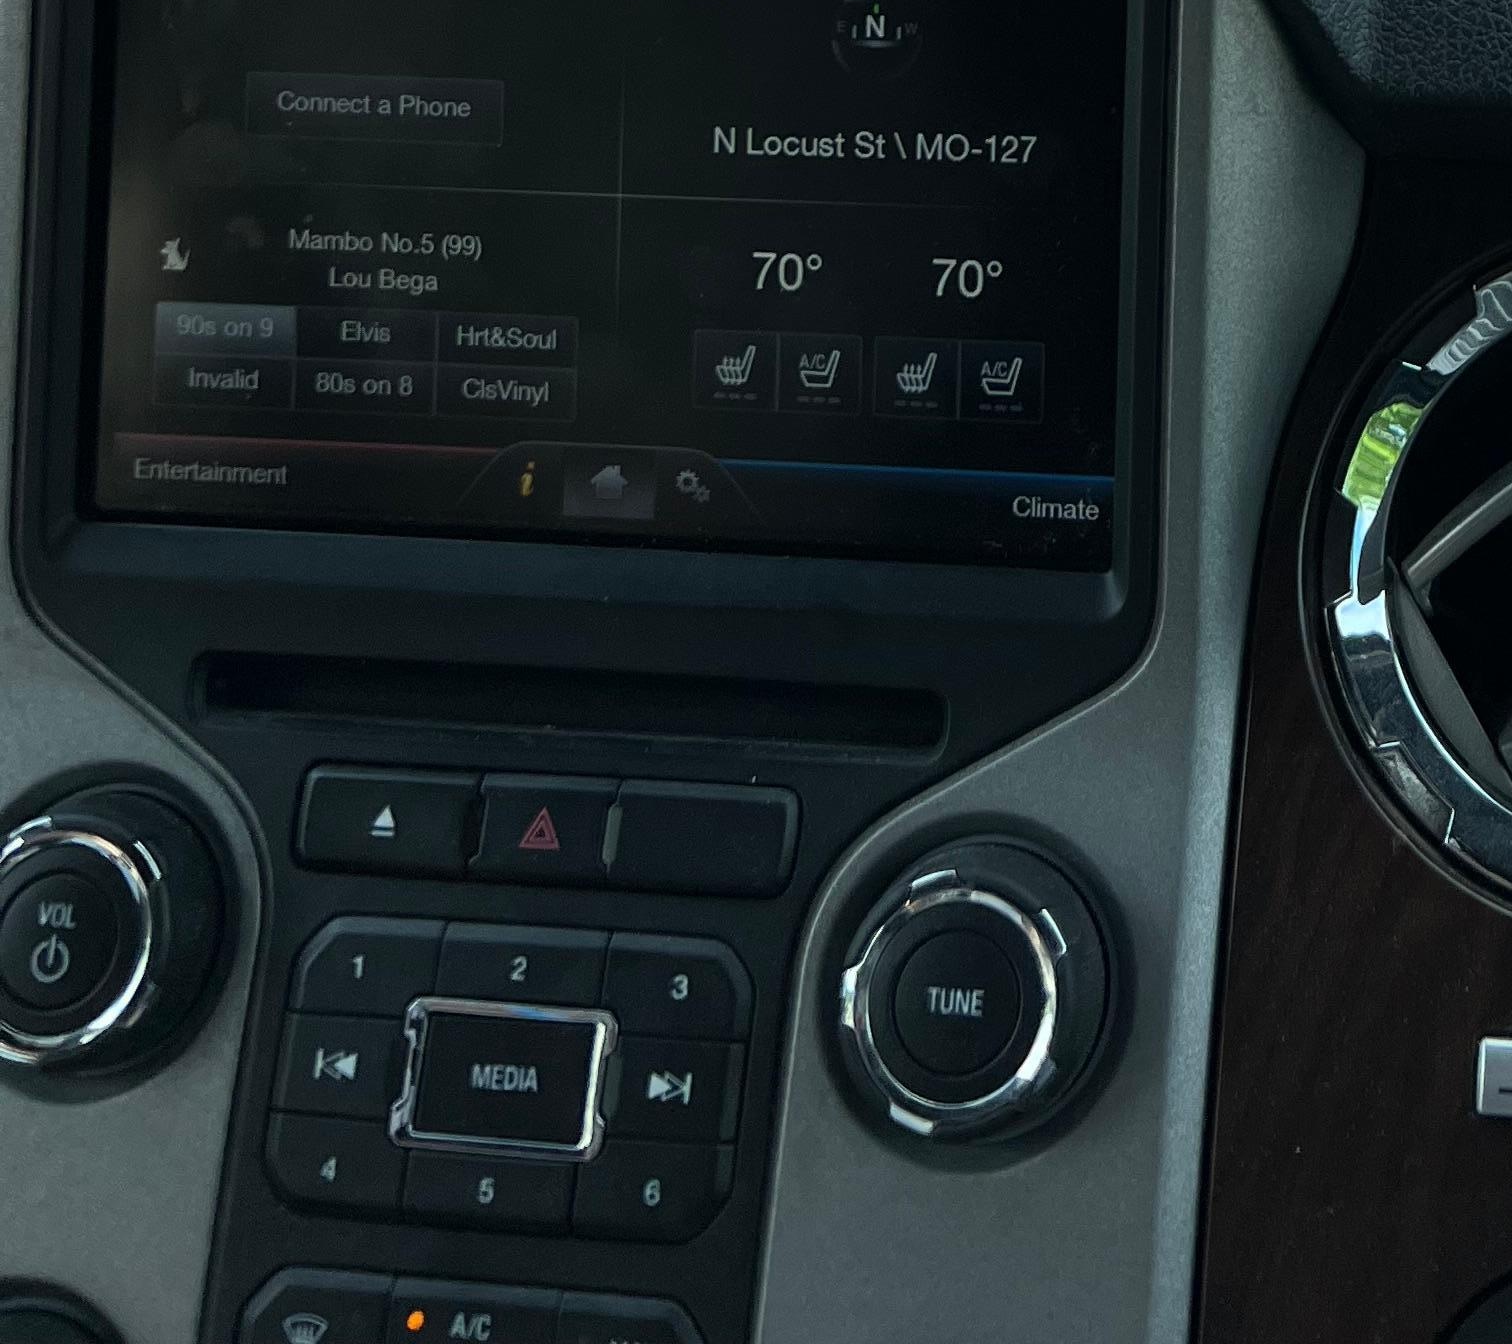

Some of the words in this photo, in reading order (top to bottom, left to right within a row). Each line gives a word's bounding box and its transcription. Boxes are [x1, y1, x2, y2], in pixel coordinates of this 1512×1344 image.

[866, 15, 885, 38] N
[276, 90, 371, 116] Connect
[378, 98, 391, 115] a
[399, 95, 472, 118] Phone
[713, 127, 737, 154] N
[747, 128, 845, 158] Locust
[854, 131, 886, 159] St
[916, 133, 1038, 164] MO-127
[288, 229, 374, 253] Mambo
[382, 233, 435, 255] No.5
[441, 234, 483, 261] (99)
[329, 267, 371, 289] Lou
[379, 269, 439, 296] Bega
[752, 251, 823, 292] 70°
[931, 258, 1004, 298] 70°
[176, 314, 217, 337] 90s
[224, 321, 253, 338] on
[259, 316, 274, 339] 9
[340, 321, 391, 343] Elvis
[456, 326, 558, 350] Hrt&Soul
[188, 367, 260, 391] Invalid
[315, 372, 356, 395] 80s
[364, 378, 391, 396] on
[398, 374, 413, 397] 8
[462, 377, 550, 405] ClsVinyl
[133, 458, 288, 486] Entertainment
[1012, 495, 1100, 521] Climate
[39, 904, 76, 929] VOL
[350, 956, 364, 979] 1
[509, 958, 527, 982] 2
[670, 975, 690, 1000] 3
[926, 985, 985, 1017] TUNE
[471, 1064, 540, 1093] MEDIA
[320, 1157, 338, 1181] 4
[477, 1177, 495, 1204] 5
[642, 1180, 661, 1206] 6
[450, 1313, 491, 1341] A/C
